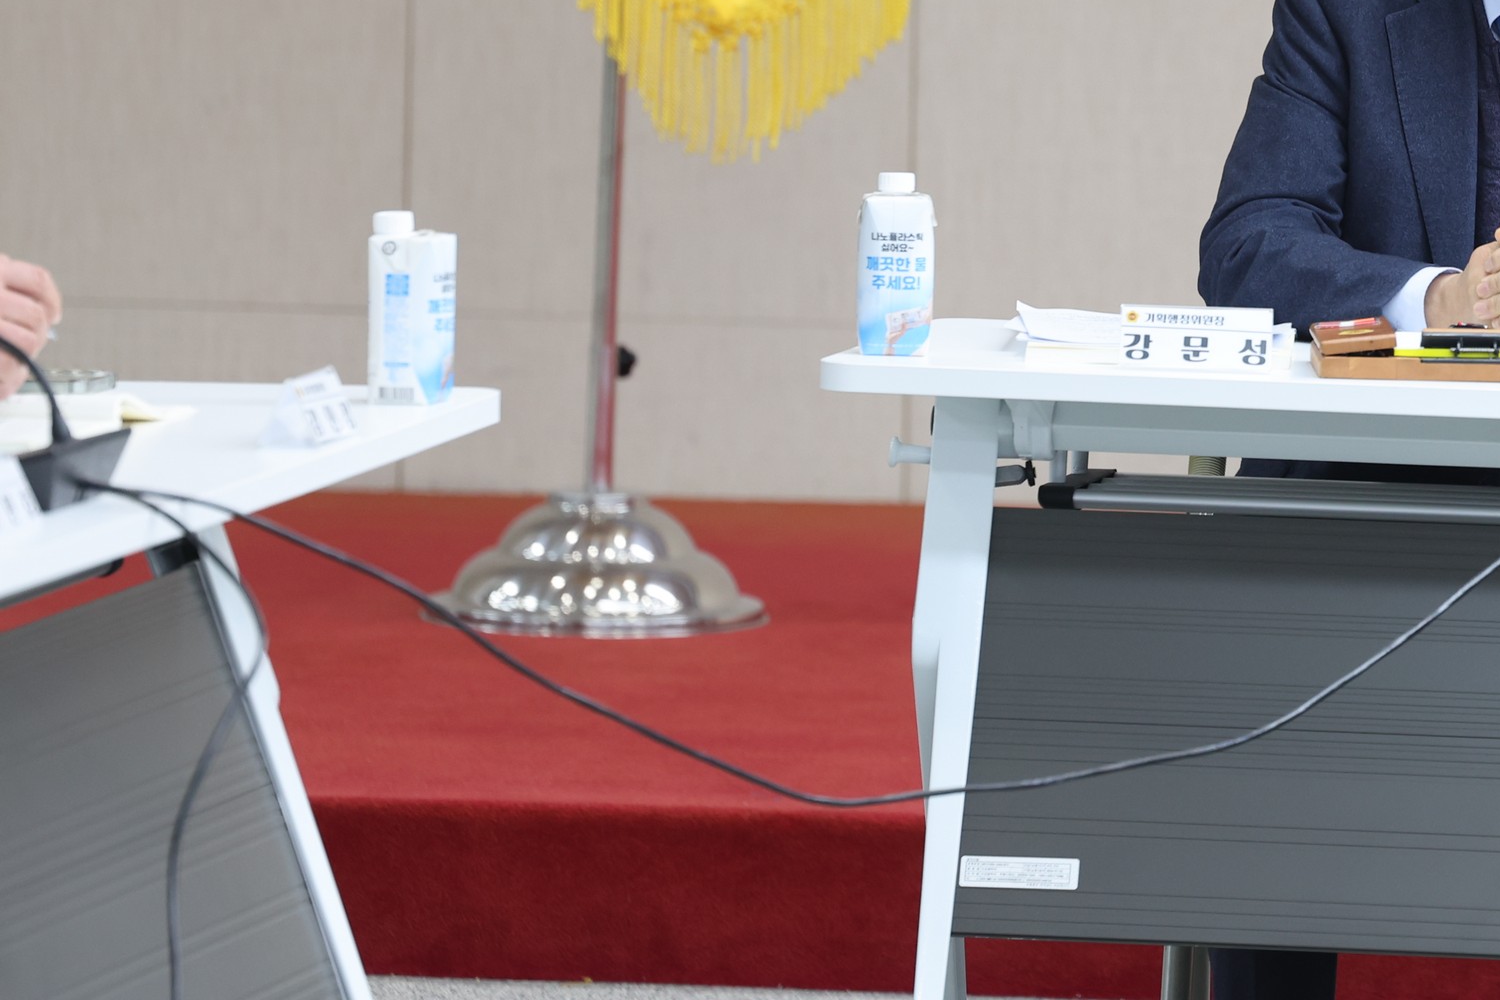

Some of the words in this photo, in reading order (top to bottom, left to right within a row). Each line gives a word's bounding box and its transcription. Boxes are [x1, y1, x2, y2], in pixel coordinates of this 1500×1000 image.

[866, 256, 911, 272] 깨끗한
[915, 257, 927, 272] 물
[871, 275, 921, 291] 주세요!
[1145, 312, 1225, 326] 기획행정위원장
